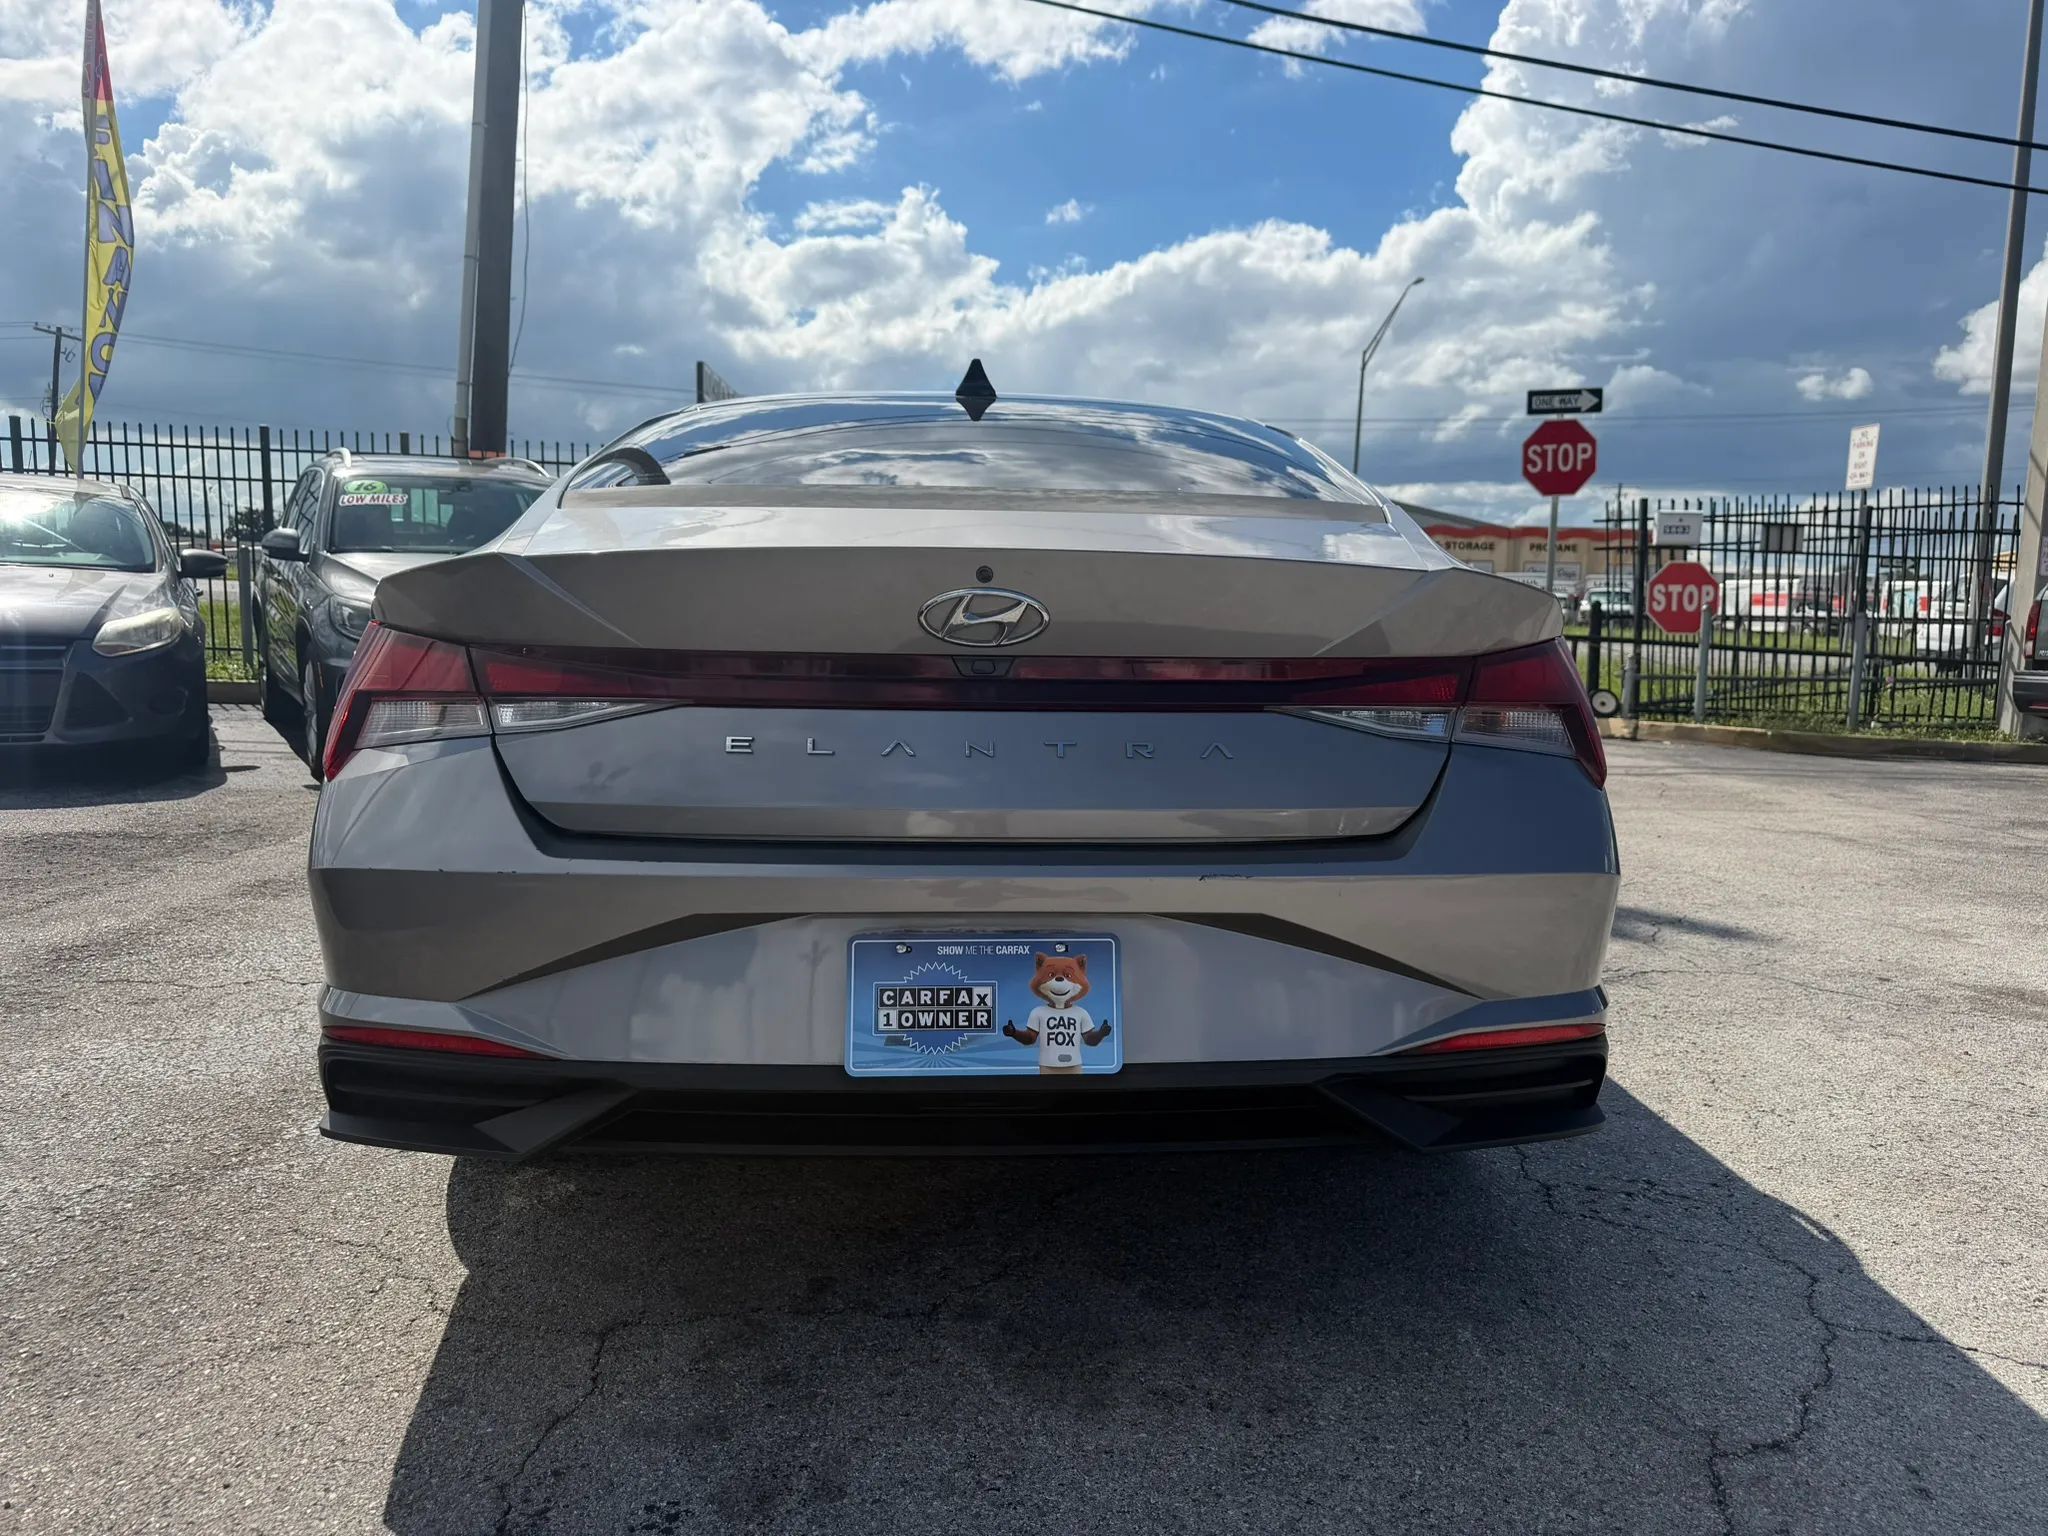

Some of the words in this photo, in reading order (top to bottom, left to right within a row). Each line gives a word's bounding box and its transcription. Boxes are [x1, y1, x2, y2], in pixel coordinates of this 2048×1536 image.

[1534, 396, 1555, 408] ONE
[1559, 394, 1579, 407] WAY
[1526, 442, 1593, 474] STOP
[354, 482, 377, 492] 16
[341, 495, 366, 504] LOW
[368, 494, 407, 504] MILES
[1444, 541, 1496, 551] STORAGE
[1529, 542, 1579, 553] PROANE
[1652, 584, 1715, 612] STOP
[725, 735, 1234, 759] ELANTRA
[937, 945, 963, 955] SHOW
[965, 945, 977, 955] ME
[979, 945, 993, 955] THE
[995, 945, 1030, 955] CARFAX
[881, 989, 990, 1007] CARFAX
[882, 1012, 894, 1028] 1
[900, 1010, 989, 1028] OWNER
[1046, 1016, 1077, 1031] CAR
[1046, 1031, 1075, 1047] FOX
